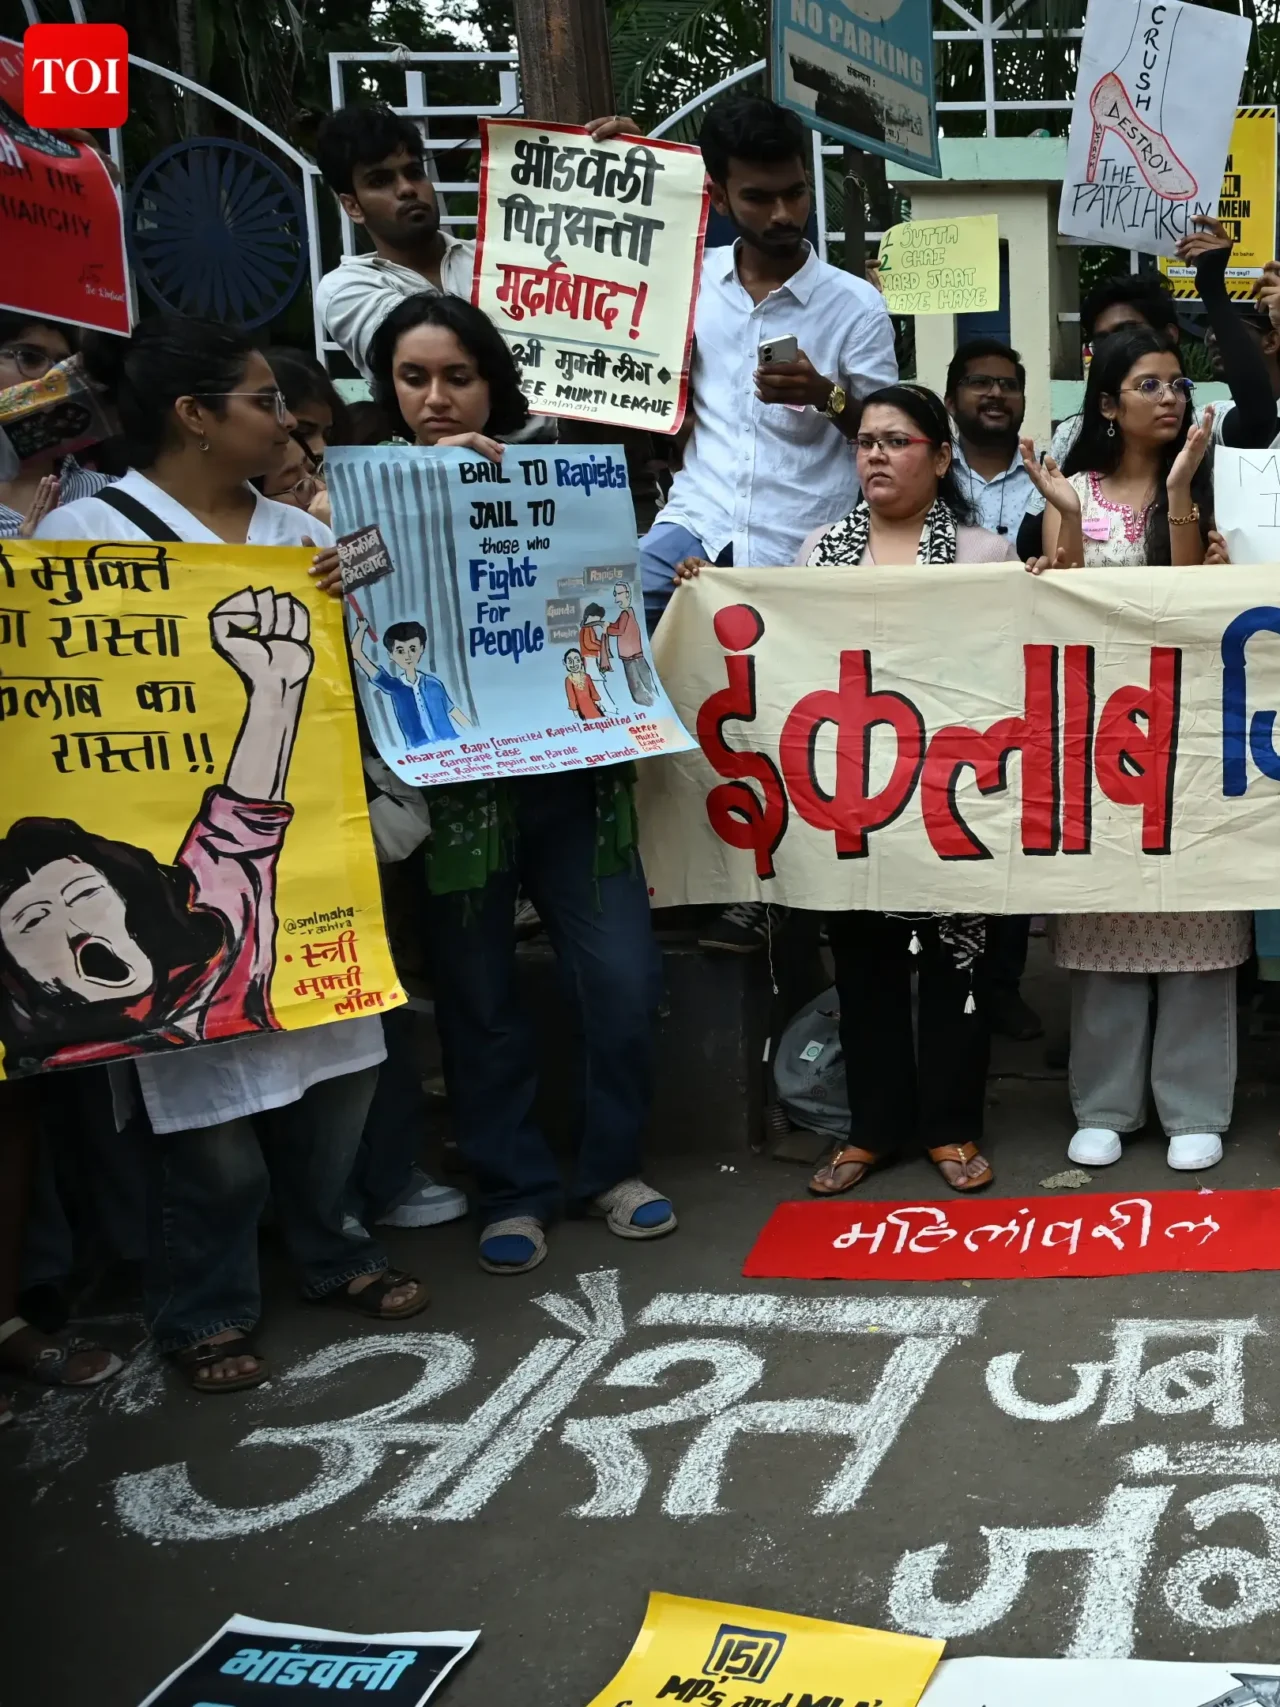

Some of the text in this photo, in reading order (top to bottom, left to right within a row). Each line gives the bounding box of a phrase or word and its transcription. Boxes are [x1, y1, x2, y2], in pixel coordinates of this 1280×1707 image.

[790, 0, 924, 87] NO PARKING
[1135, 6, 1168, 112] CRUSH
[1106, 101, 1173, 175] DESTROY
[510, 136, 666, 207] भांडवली
[1099, 158, 1137, 184] THE
[497, 193, 666, 267] पितृसत्ता
[1072, 182, 1212, 243] PATRIARCHY
[881, 223, 959, 250] 1 SUTTA
[878, 247, 946, 272] 2 CHAI
[880, 267, 977, 290] MARD JAAT
[495, 262, 649, 341] मुर्दाबाद!
[937, 287, 988, 310] HAYE
[554, 348, 613, 381] मुक्ती
[612, 352, 654, 386] लीग
[555, 384, 675, 417] MUKTI LEAGUE
[458, 454, 627, 497] BAIL TO Rapists
[468, 498, 555, 530] JAIL TO
[479, 537, 550, 555] those who
[30, 542, 183, 606] मुक्ति
[468, 555, 538, 600] Fight
[477, 601, 510, 625] For
[47, 613, 188, 659] रास्ता
[468, 620, 544, 664] People
[135, 680, 196, 714] का
[405, 748, 455, 764] Asaram
[459, 741, 491, 755] Bapu
[582, 715, 632, 734] acquitted
[634, 711, 646, 721] in
[696, 603, 1183, 881] इंकलाब
[421, 745, 579, 780] Ram Rahim again on Parole
[439, 751, 493, 769] Gangrape
[482, 769, 505, 777] are
[584, 746, 640, 767] garlands
[299, 929, 360, 968] स्त्री
[293, 965, 364, 1000] मुक्ती
[334, 988, 385, 1015] लीग
[112, 1266, 987, 1542] औरत
[984, 1313, 1270, 1429] जब
[219, 1643, 419, 1691] भांडवली
[713, 1638, 773, 1678] 151
[655, 1674, 730, 1707] MP's
